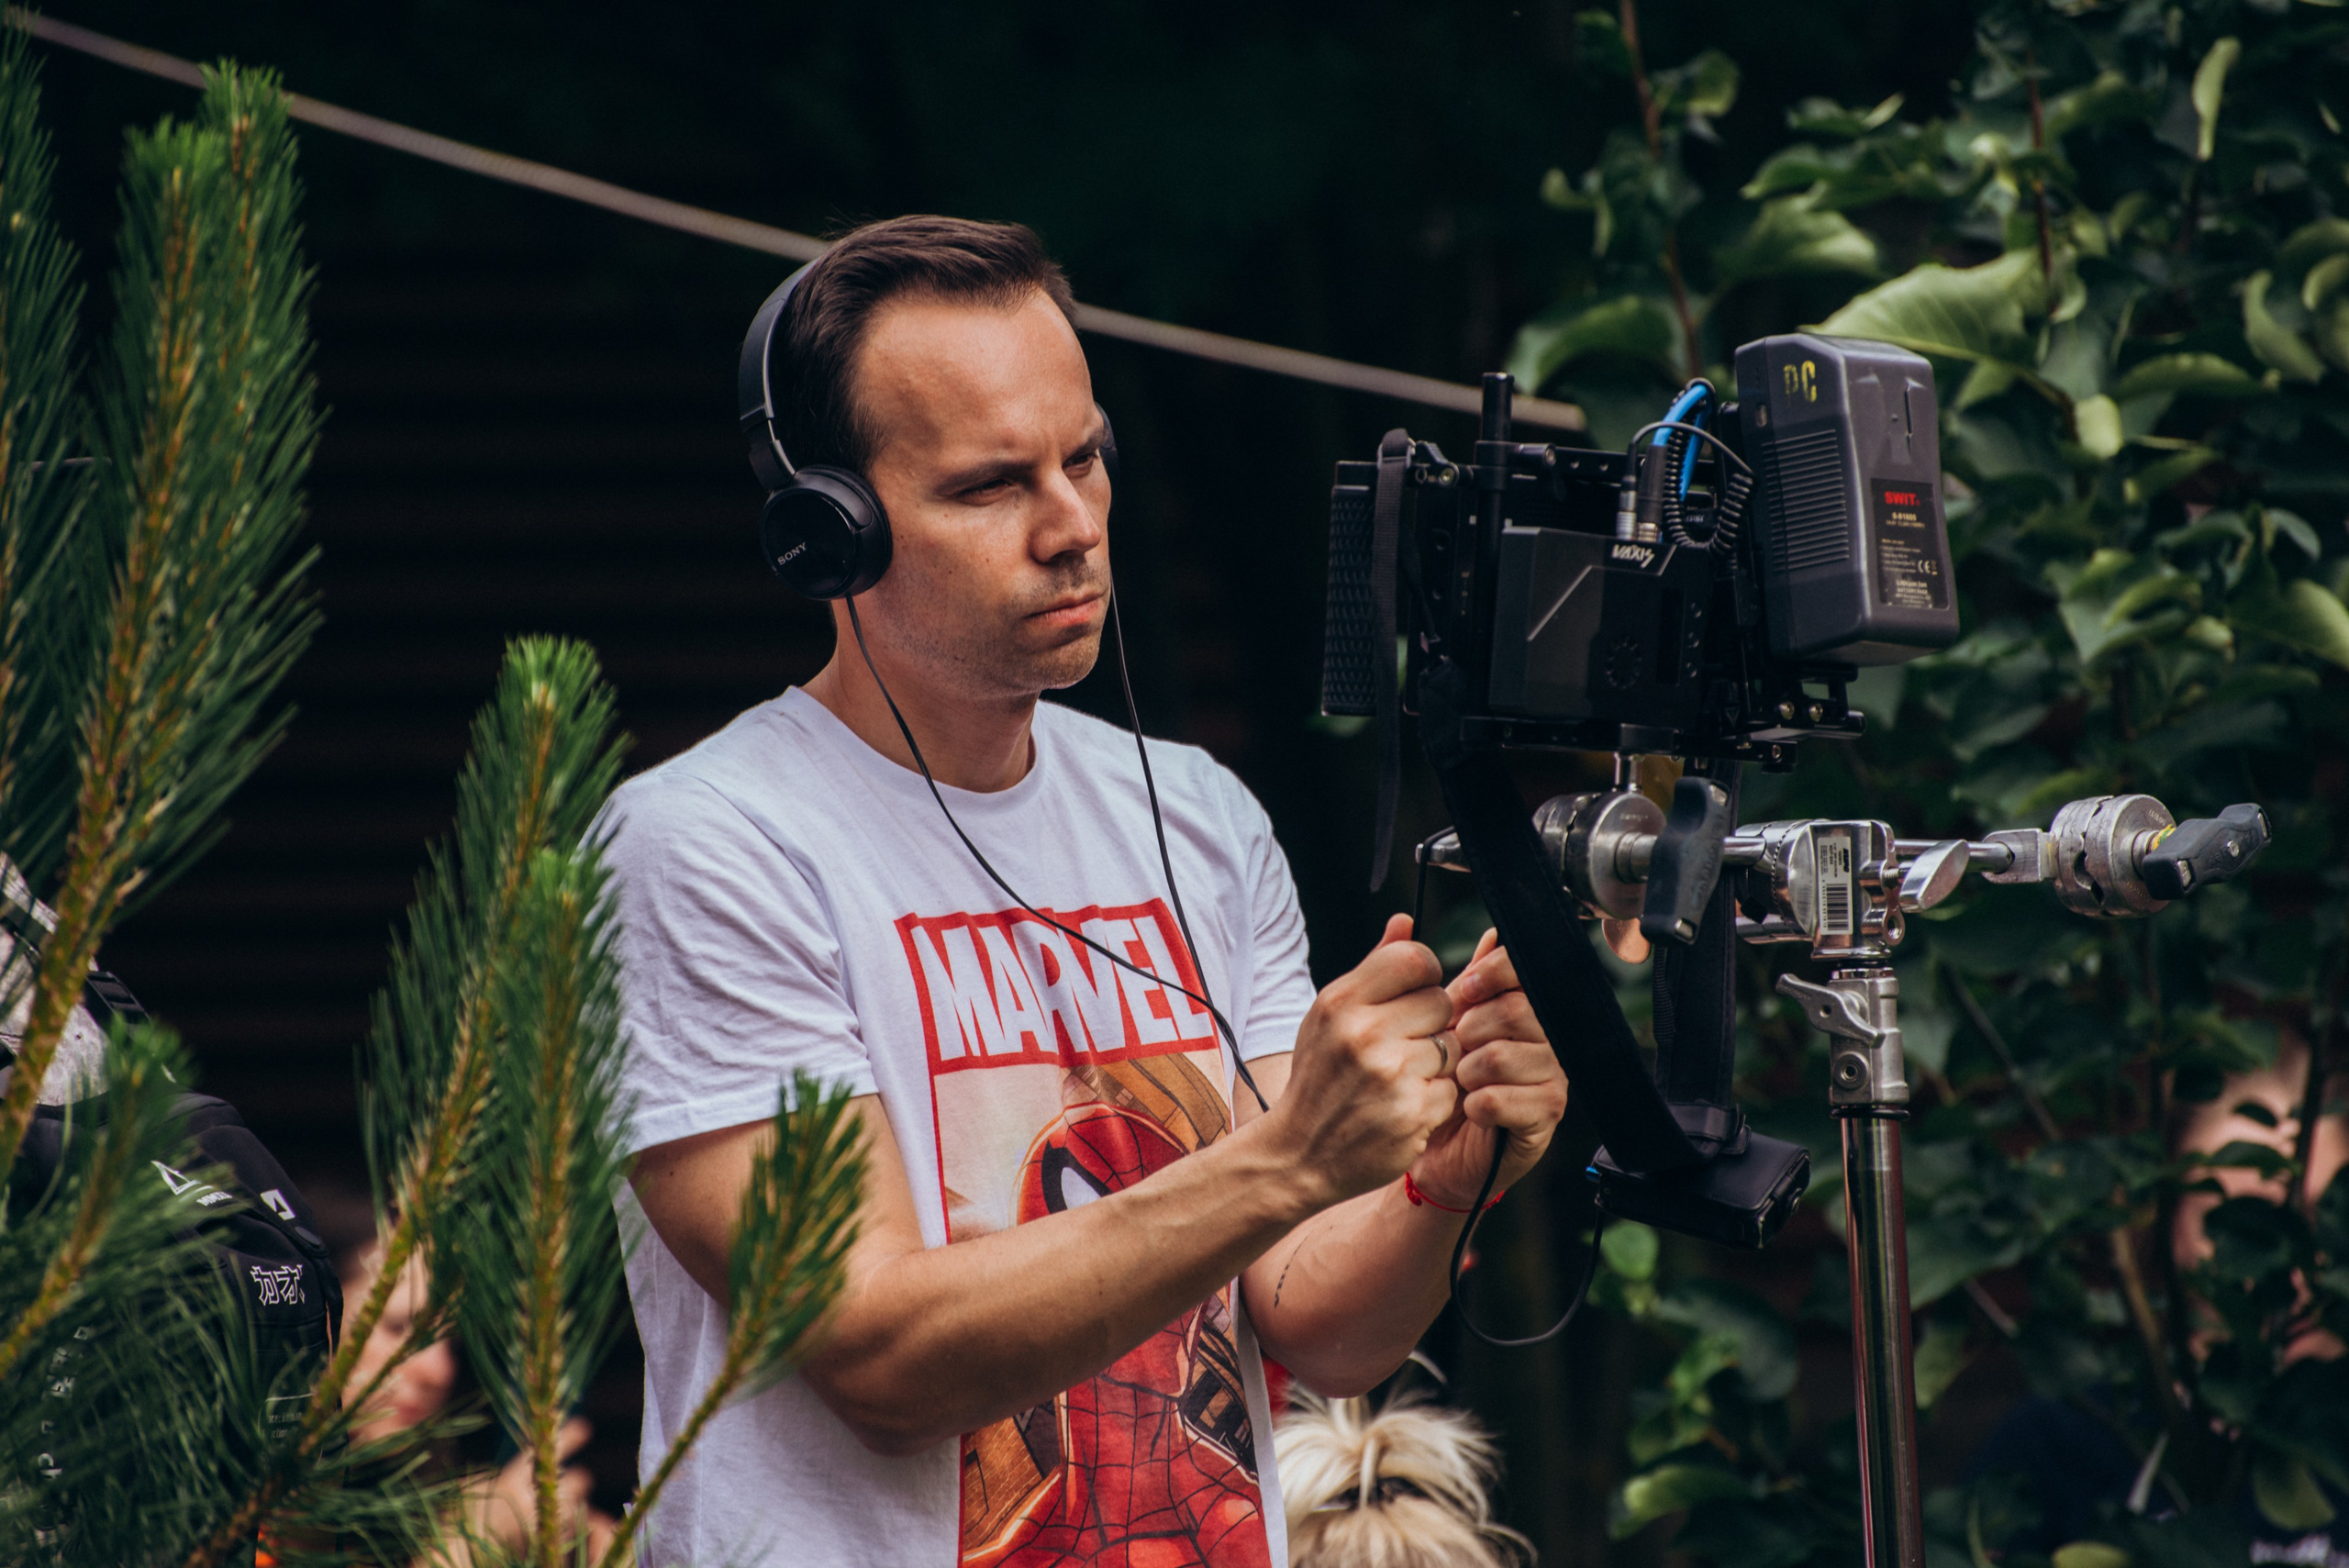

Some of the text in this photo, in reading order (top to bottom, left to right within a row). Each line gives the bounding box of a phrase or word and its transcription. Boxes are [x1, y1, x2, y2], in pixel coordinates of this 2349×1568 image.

[1783, 361, 1817, 403] DC
[1884, 491, 1916, 506] SWIT
[777, 541, 807, 566] SONY
[1611, 544, 1654, 568] VAXIS
[909, 915, 1214, 1062] MARVEL
